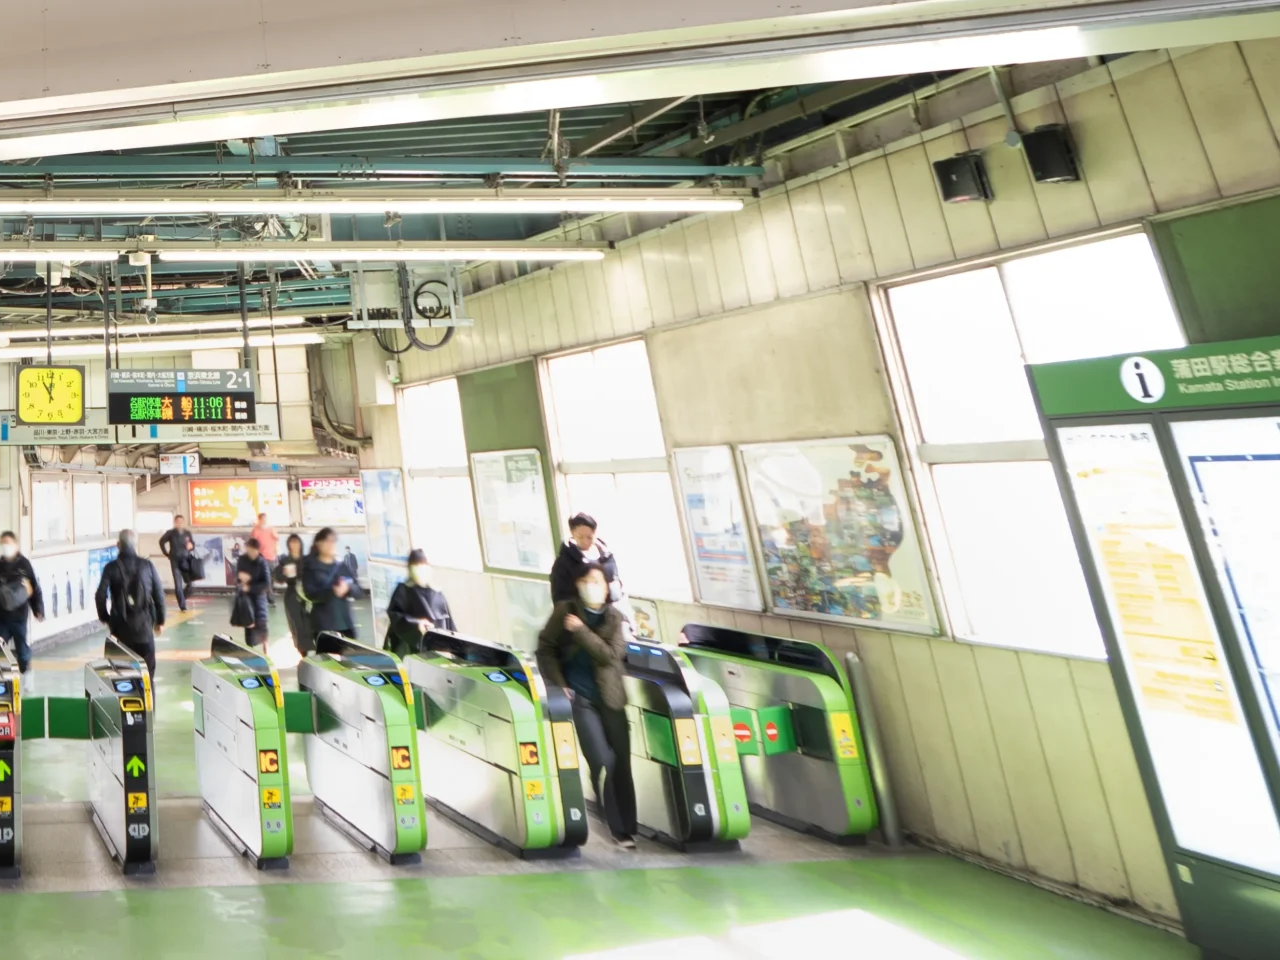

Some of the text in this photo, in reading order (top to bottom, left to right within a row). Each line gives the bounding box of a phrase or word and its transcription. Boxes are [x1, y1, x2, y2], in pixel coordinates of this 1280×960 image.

[1178, 382, 1224, 394] Kamata
[1224, 378, 1271, 391] Station
[193, 397, 224, 408] 11:06
[225, 396, 232, 408] 1
[193, 408, 222, 419] 11:11
[226, 408, 232, 420] 1
[188, 455, 197, 468] 2
[260, 751, 278, 772] IC
[392, 748, 411, 769] IC
[520, 743, 538, 765] IC
